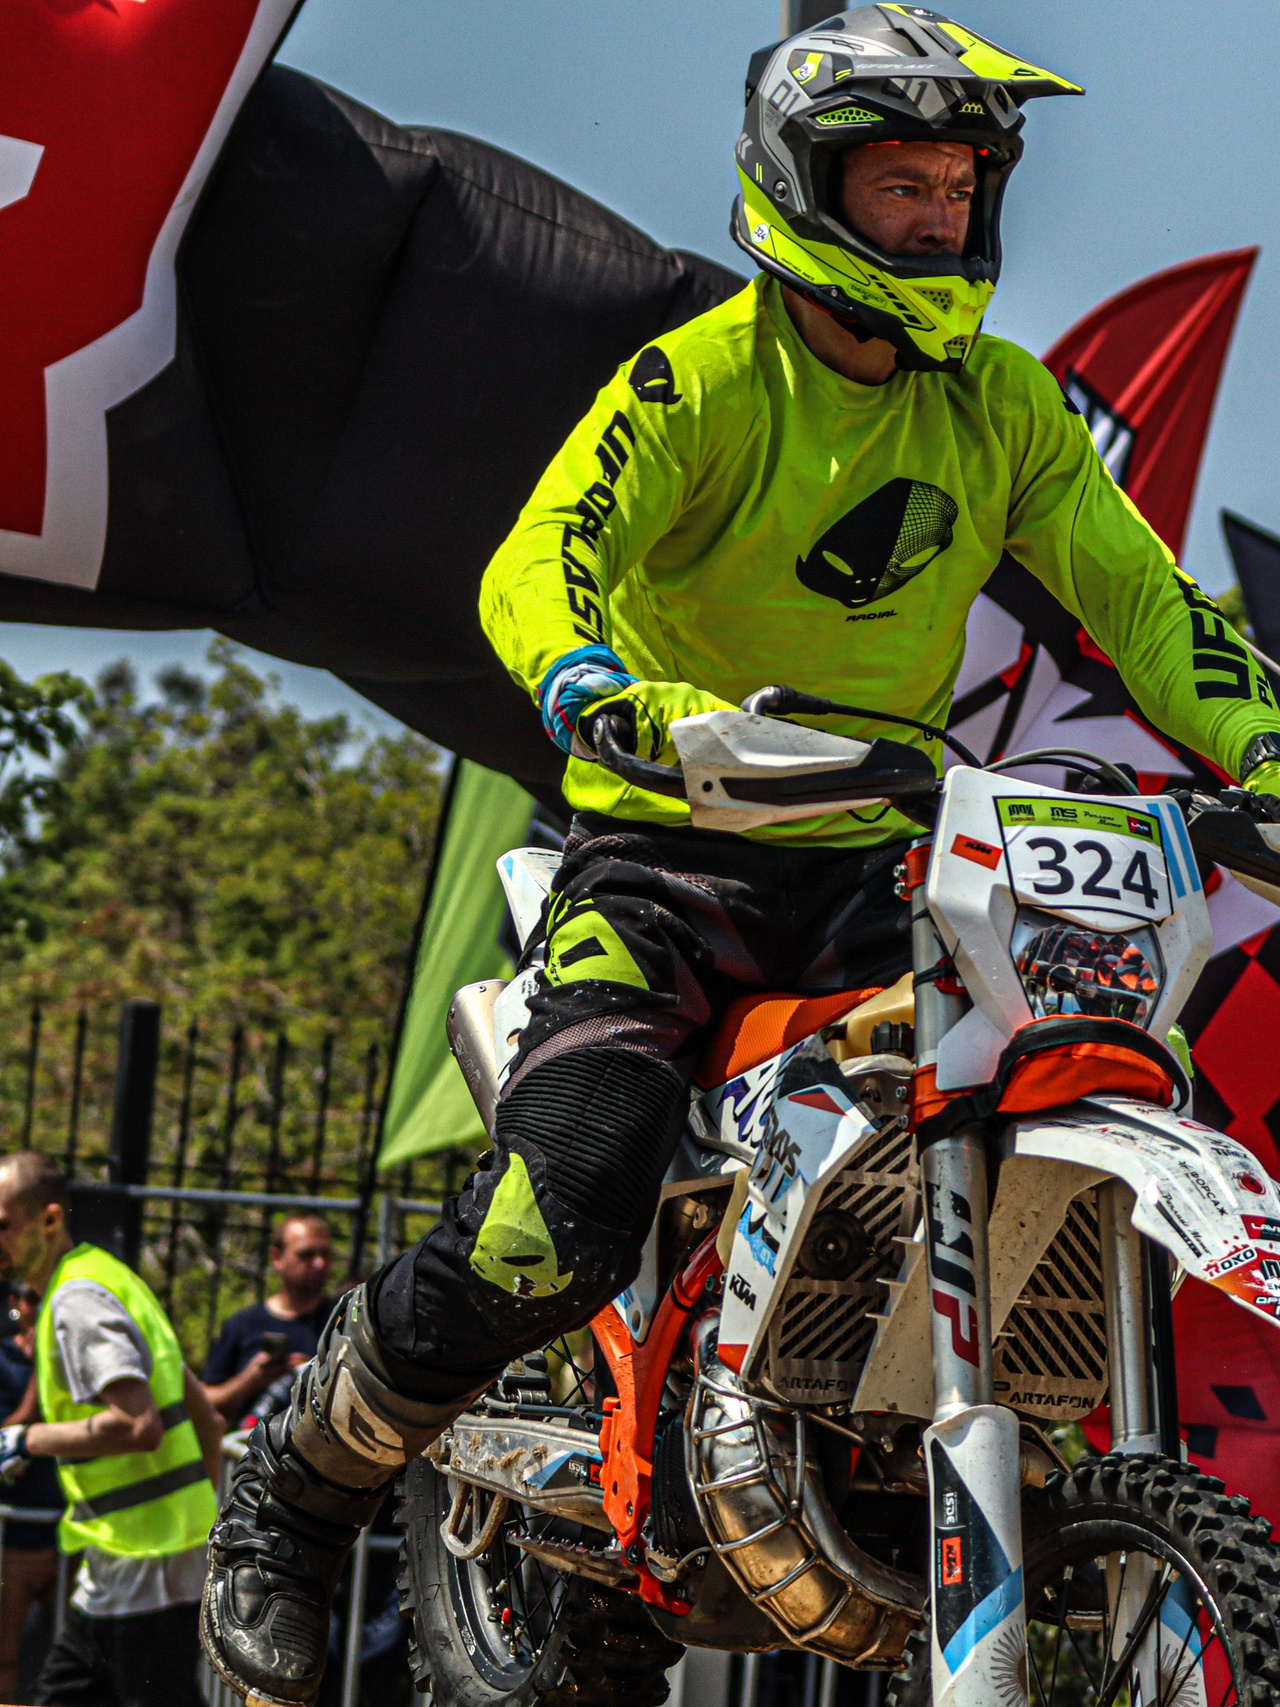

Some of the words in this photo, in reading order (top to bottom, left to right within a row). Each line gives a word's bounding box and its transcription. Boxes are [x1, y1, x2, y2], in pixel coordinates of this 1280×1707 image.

[844, 608, 899, 622] RADIAL
[964, 840, 993, 856] KTM
[1025, 836, 1160, 910] 324
[1190, 1171, 1230, 1217] ФОРСАЖ
[729, 1272, 756, 1312] KTM
[1009, 1390, 1096, 1409] ARTAFON
[946, 1491, 955, 1524] ISDE
